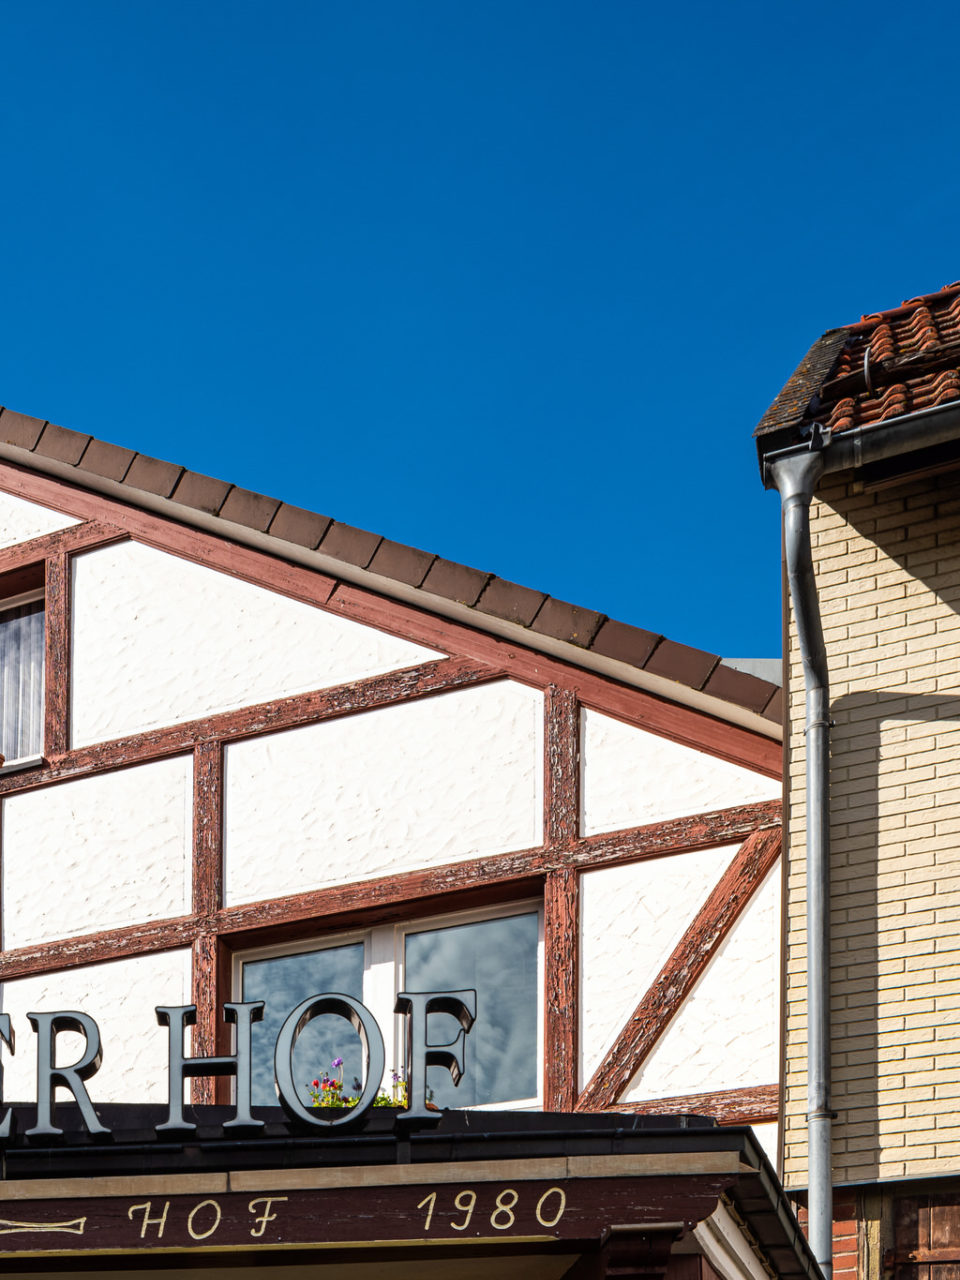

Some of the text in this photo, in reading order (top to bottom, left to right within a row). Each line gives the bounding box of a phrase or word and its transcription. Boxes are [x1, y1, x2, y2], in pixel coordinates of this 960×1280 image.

[154, 989, 478, 1134] HOF
[127, 1196, 289, 1241] HOF
[417, 1187, 566, 1231] 1980
